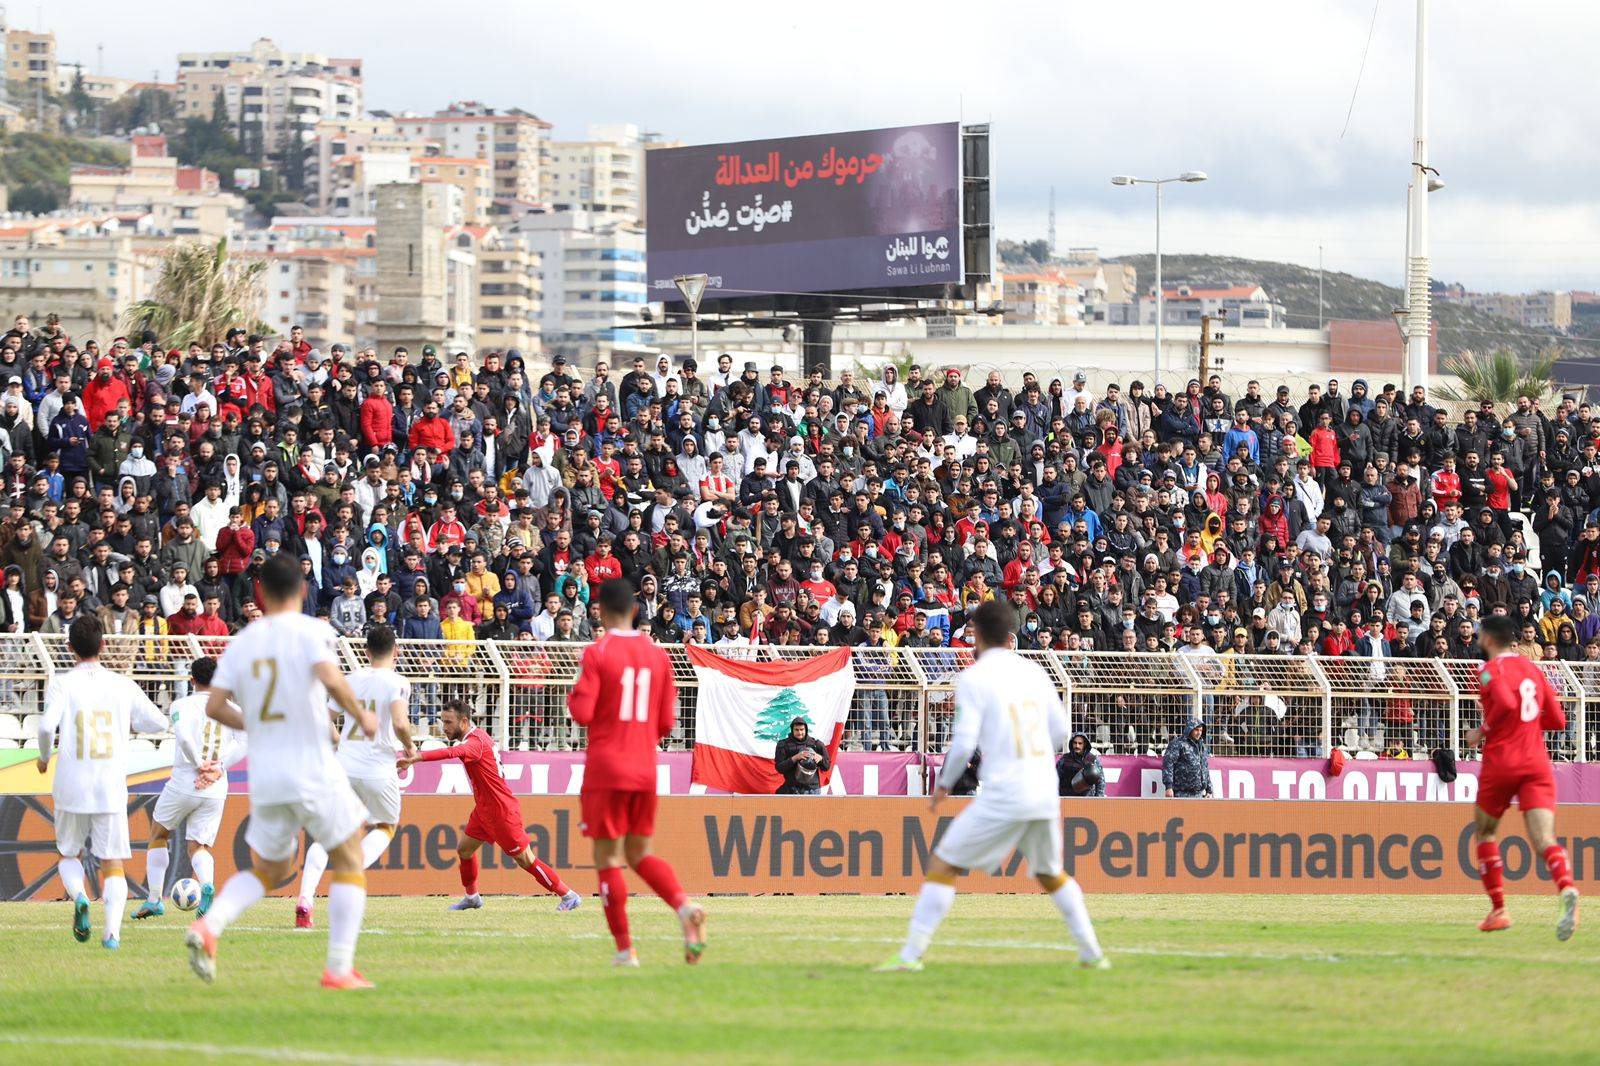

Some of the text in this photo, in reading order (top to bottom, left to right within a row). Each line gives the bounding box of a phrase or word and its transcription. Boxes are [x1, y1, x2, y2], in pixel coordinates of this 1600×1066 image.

[715, 147, 885, 188] حرموك من العدالة
[886, 236, 918, 262] للبنان
[886, 262, 951, 276] Sawa Li Lubnan
[252, 657, 285, 722] 2
[619, 666, 652, 722] 11
[1519, 678, 1540, 723] 8
[75, 709, 113, 760] 16
[1007, 700, 1046, 759] 12
[1272, 770, 1326, 801] TO
[703, 815, 883, 877] When
[1062, 816, 1444, 880] Performance
